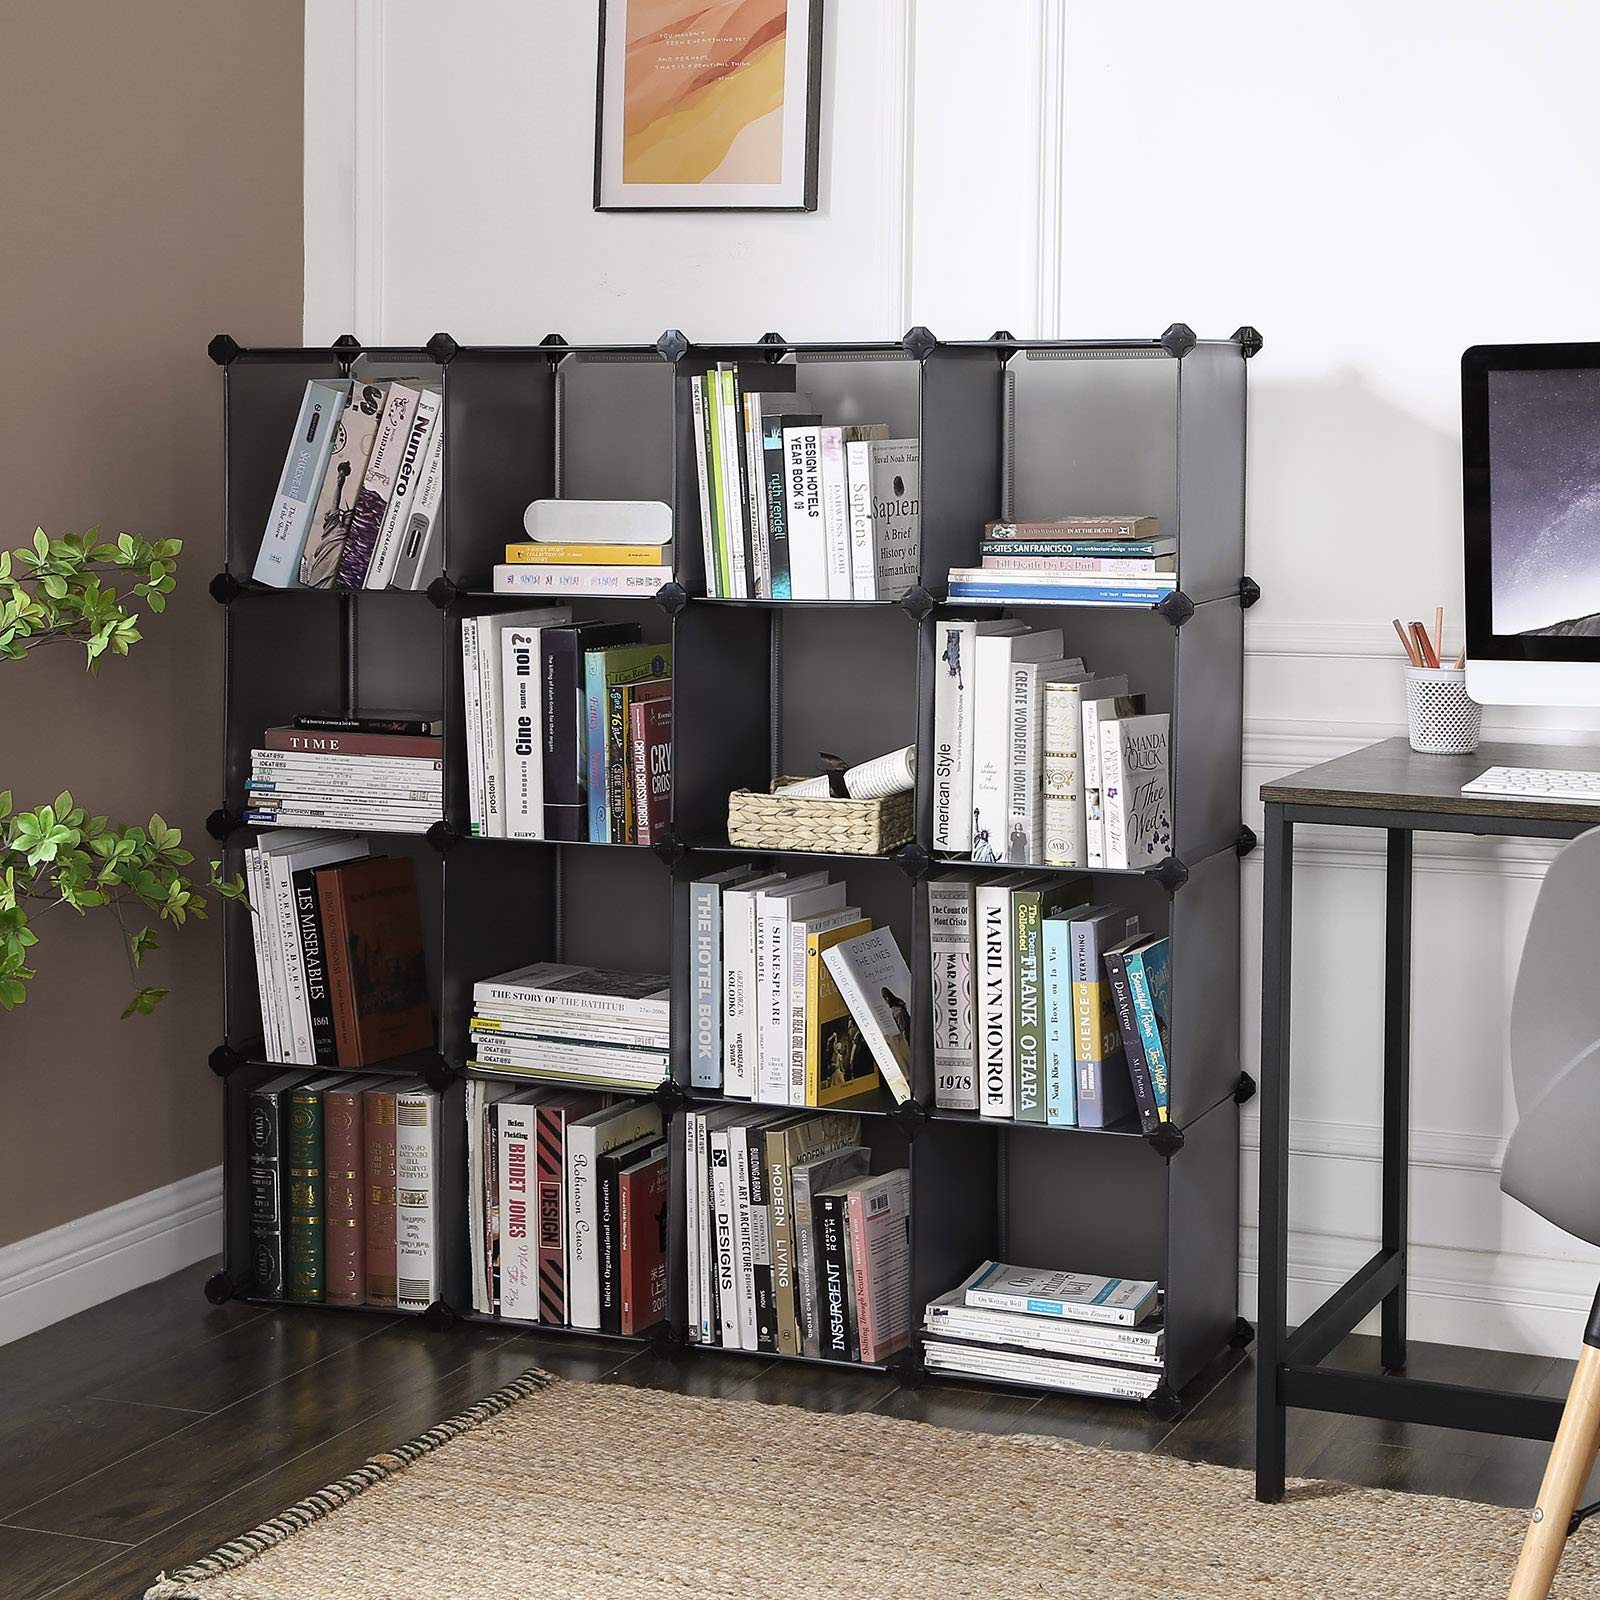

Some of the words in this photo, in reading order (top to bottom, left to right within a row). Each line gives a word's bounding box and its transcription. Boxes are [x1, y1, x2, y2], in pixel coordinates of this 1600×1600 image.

[396, 416, 430, 497] Numéro
[791, 436, 802, 465] YEAR
[805, 436, 816, 473] DESIGN
[772, 473, 781, 504] ruth
[792, 469, 804, 498] BOOK
[806, 476, 819, 518] HOTELS
[774, 506, 786, 540] rendell
[850, 484, 868, 547] Sapiens
[872, 496, 919, 525] Sapien
[884, 531, 890, 541] A
[892, 527, 912, 540] Brief
[1014, 544, 1029, 552] SAN
[1030, 544, 1072, 553] FRANCISCO
[880, 547, 907, 561] History
[908, 544, 918, 556] of
[879, 562, 919, 578] Humankin
[1015, 670, 1028, 704] CREATE
[290, 737, 340, 750] TIME
[516, 716, 532, 756] Cine
[1014, 707, 1027, 766] WONDERFUL
[1126, 732, 1167, 753] AMANDA
[634, 740, 646, 772] CRYPTIC
[938, 743, 954, 777] Style
[1127, 750, 1164, 770] QUICK
[489, 775, 498, 814] prostoria
[614, 788, 622, 813] LIMB
[635, 774, 649, 825] CROSSWORDS
[1013, 769, 1026, 816] HOMELIFE
[1130, 786, 1141, 814] I
[1140, 776, 1166, 807] Thee
[936, 782, 951, 846] American
[1127, 812, 1161, 844] Wed
[297, 888, 314, 916] LES
[698, 894, 711, 932] THE
[932, 906, 943, 915] The
[944, 906, 959, 915] Count
[960, 906, 968, 914] Of
[792, 926, 804, 950] DENISE
[933, 918, 948, 926] Mont
[949, 917, 967, 926] Cristo
[1018, 904, 1028, 952] Collected
[301, 916, 325, 1000] MISERABLES
[852, 937, 883, 955] OUTSIDE
[856, 956, 870, 968] THE
[872, 949, 891, 963] LINES
[987, 906, 1002, 1006] MARILYN
[1078, 934, 1087, 982] EVERYTHING
[698, 936, 712, 999] HOTEL
[772, 926, 781, 1026] SHAKESPEARE
[793, 952, 804, 987] RICHARDS
[947, 954, 956, 978] WAR
[1050, 968, 1057, 977] la
[491, 990, 511, 999] THE
[513, 992, 542, 1003] STORY
[545, 995, 558, 1004] OF
[560, 997, 580, 1008] THE
[581, 999, 625, 1012] BATHTUB
[830, 955, 849, 988] OUTSIDE
[846, 988, 857, 1004] THE
[855, 1004, 870, 1029] LINES
[948, 981, 957, 1004] AND
[1020, 955, 1038, 1028] FRANK
[1051, 983, 1058, 995] ou
[1080, 982, 1089, 995] OF
[1131, 970, 1148, 1011] Beautiful
[1141, 1011, 1154, 1038] Ruins
[313, 1017, 329, 1026] 1861
[793, 1006, 803, 1018] THE
[1114, 981, 1124, 1004] Dark
[1119, 1004, 1132, 1031] Mirror
[698, 1004, 712, 1058] BOOK
[792, 1036, 803, 1049] GIRL
[793, 1019, 803, 1035] REAL
[948, 1008, 958, 1048] PEACE
[1052, 1030, 1059, 1042] La
[1081, 997, 1092, 1060] SCIENCE
[792, 1050, 803, 1067] NEXT
[987, 1008, 1004, 1106] MONROE
[1148, 1046, 1160, 1065] Jess
[792, 1068, 803, 1086] DOOR
[938, 1075, 972, 1090] 1978
[1021, 1035, 1038, 1111] O'HARA
[1153, 1064, 1167, 1095] Walter
[1052, 1079, 1060, 1101] Noah
[504, 1132, 528, 1140] Fielding
[796, 1148, 825, 1163] MODERN
[830, 1137, 853, 1152] LIVING
[508, 1144, 526, 1193] BRIDET
[573, 1154, 588, 1216] Robinson
[602, 1180, 611, 1222] Cybernetics
[772, 1164, 785, 1227] MODERN
[509, 1199, 527, 1239] JONES
[542, 1189, 558, 1243] DESIGN
[575, 1220, 589, 1262] Crusoe
[740, 1212, 752, 1273] ARCHITECTURE
[829, 1218, 837, 1251] ROTH
[603, 1225, 611, 1278] Organizational
[719, 1214, 732, 1290] DESIGNS
[776, 1240, 789, 1288] LIVING
[1008, 1277, 1036, 1288] On
[1059, 1281, 1093, 1296] Well
[826, 1260, 845, 1350] INSURGENT
[988, 1297, 1009, 1307] Writing
[1010, 1300, 1022, 1308] Well
